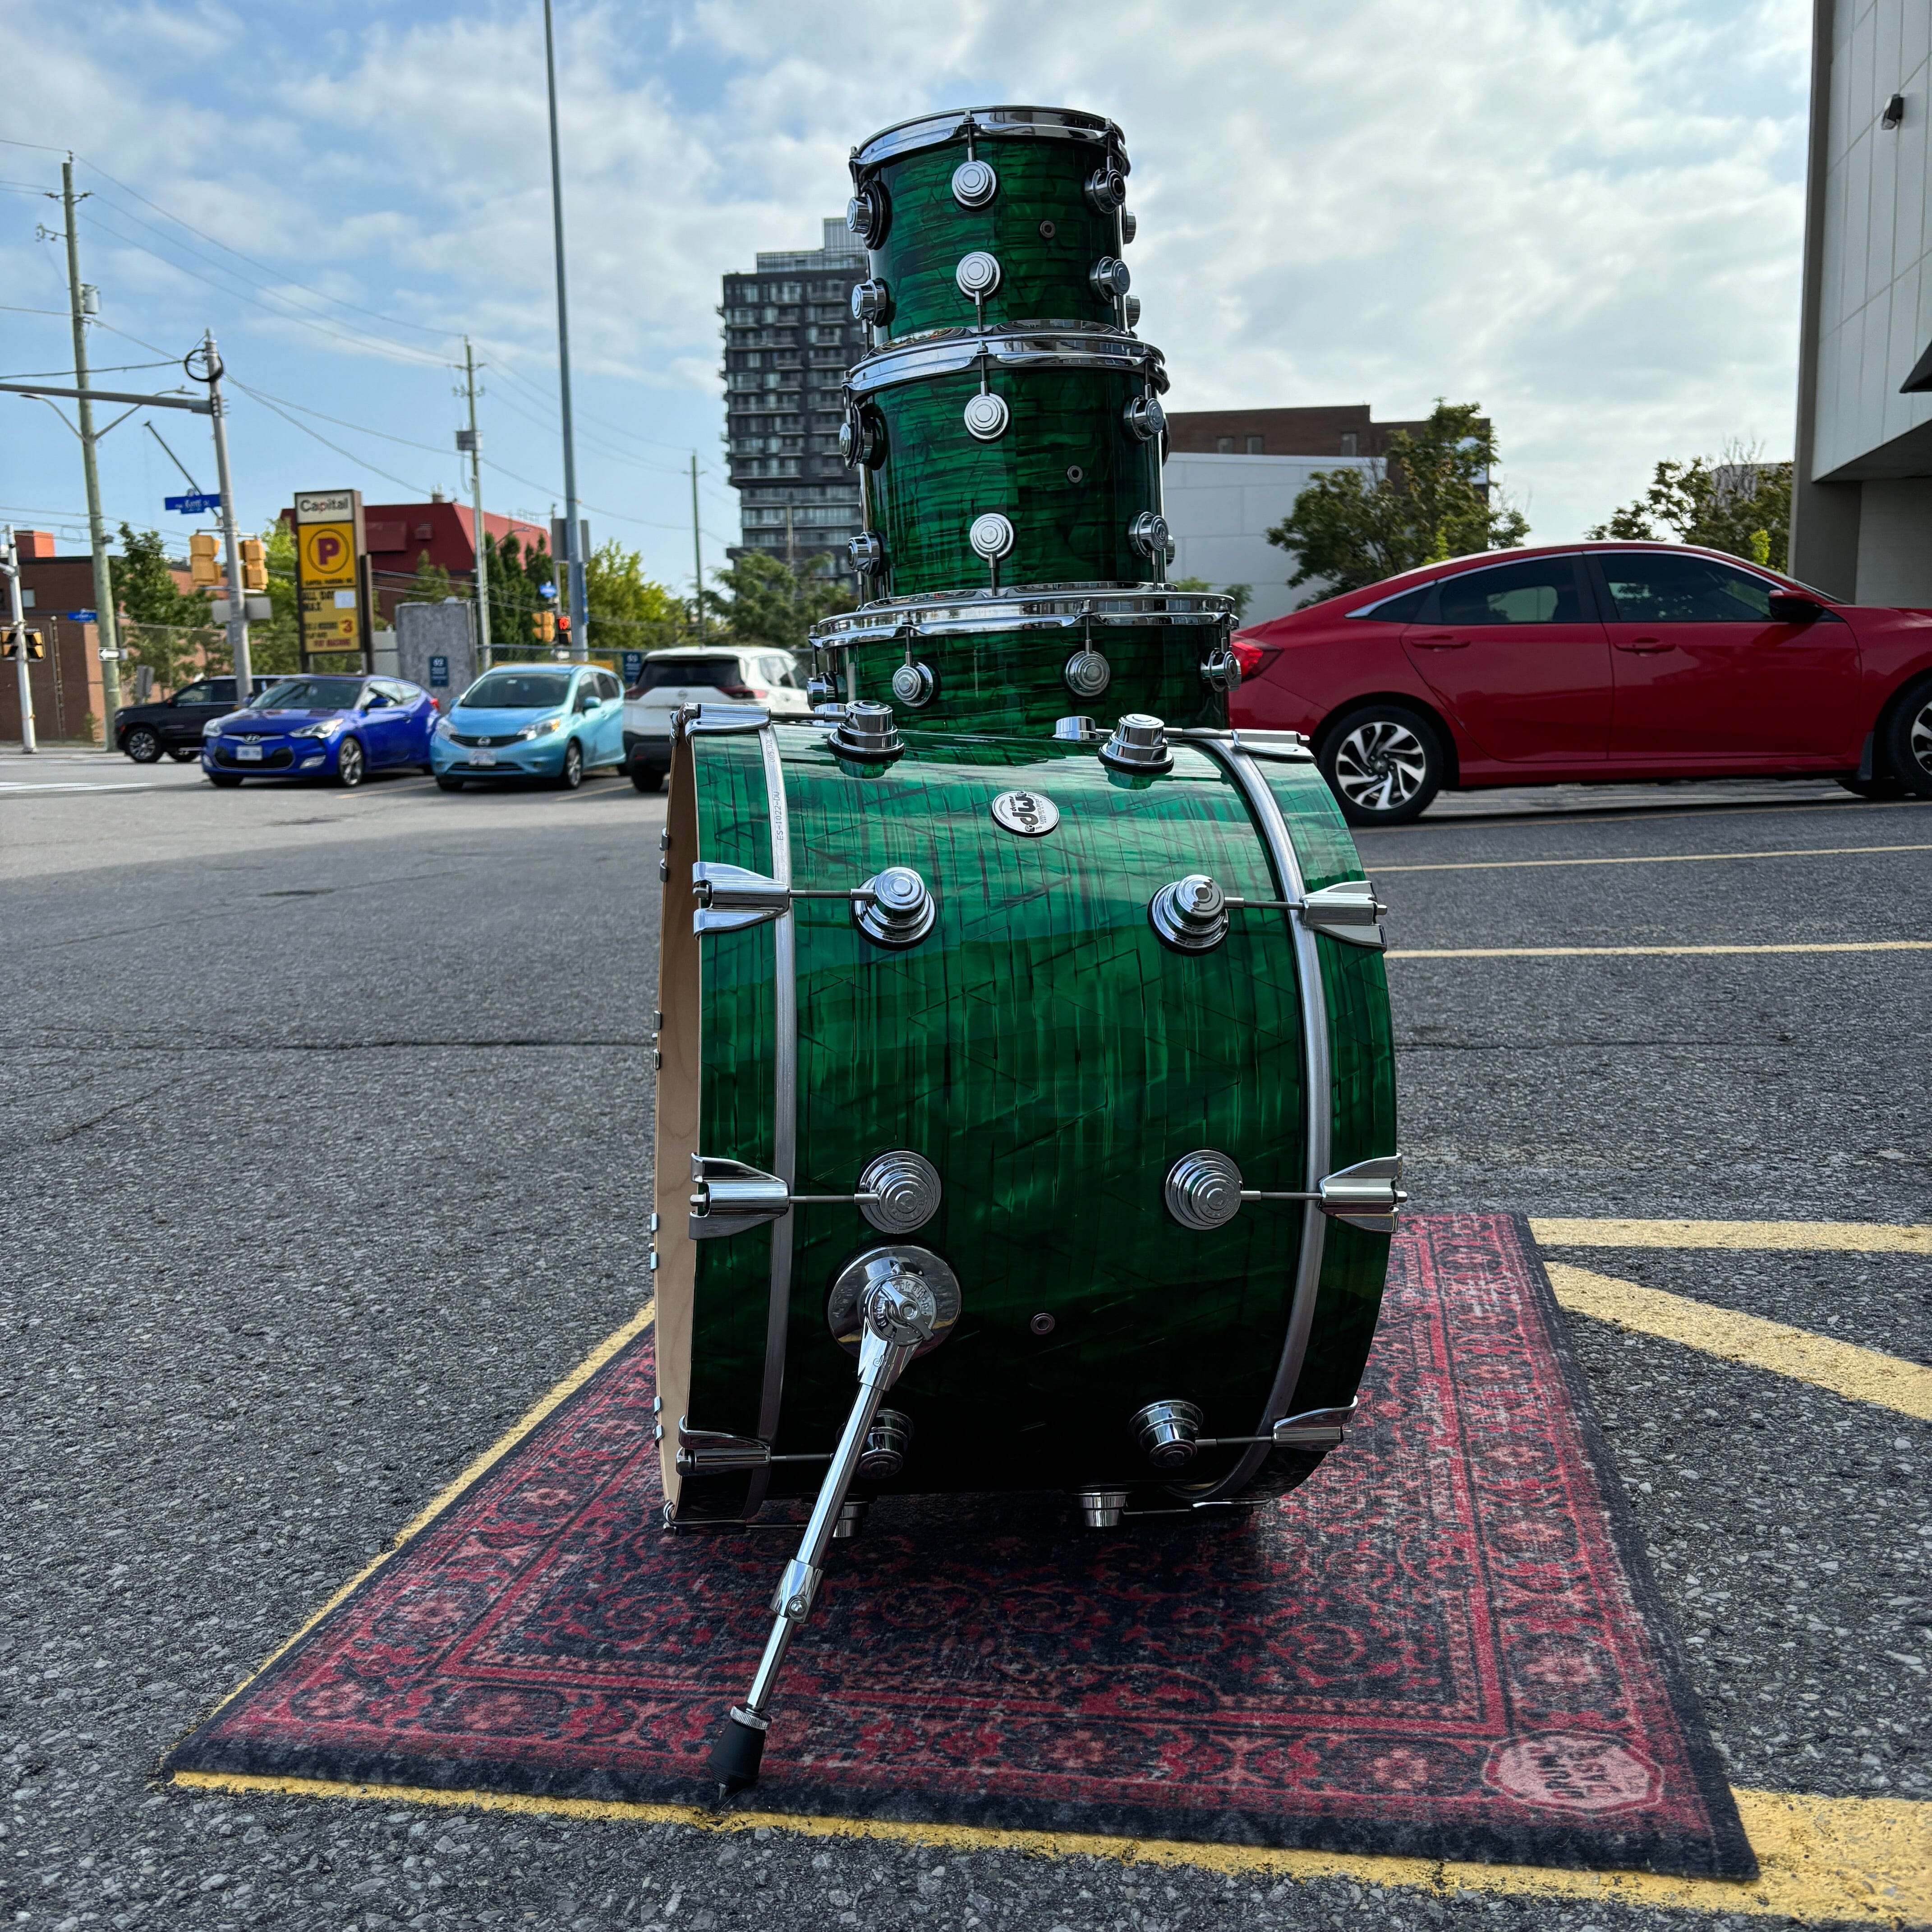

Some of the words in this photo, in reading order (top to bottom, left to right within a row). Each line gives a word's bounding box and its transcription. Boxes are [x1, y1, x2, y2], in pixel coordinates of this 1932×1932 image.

[300, 497, 348, 514] Capital
[317, 538, 340, 565] P
[1012, 796, 1039, 825] dw
